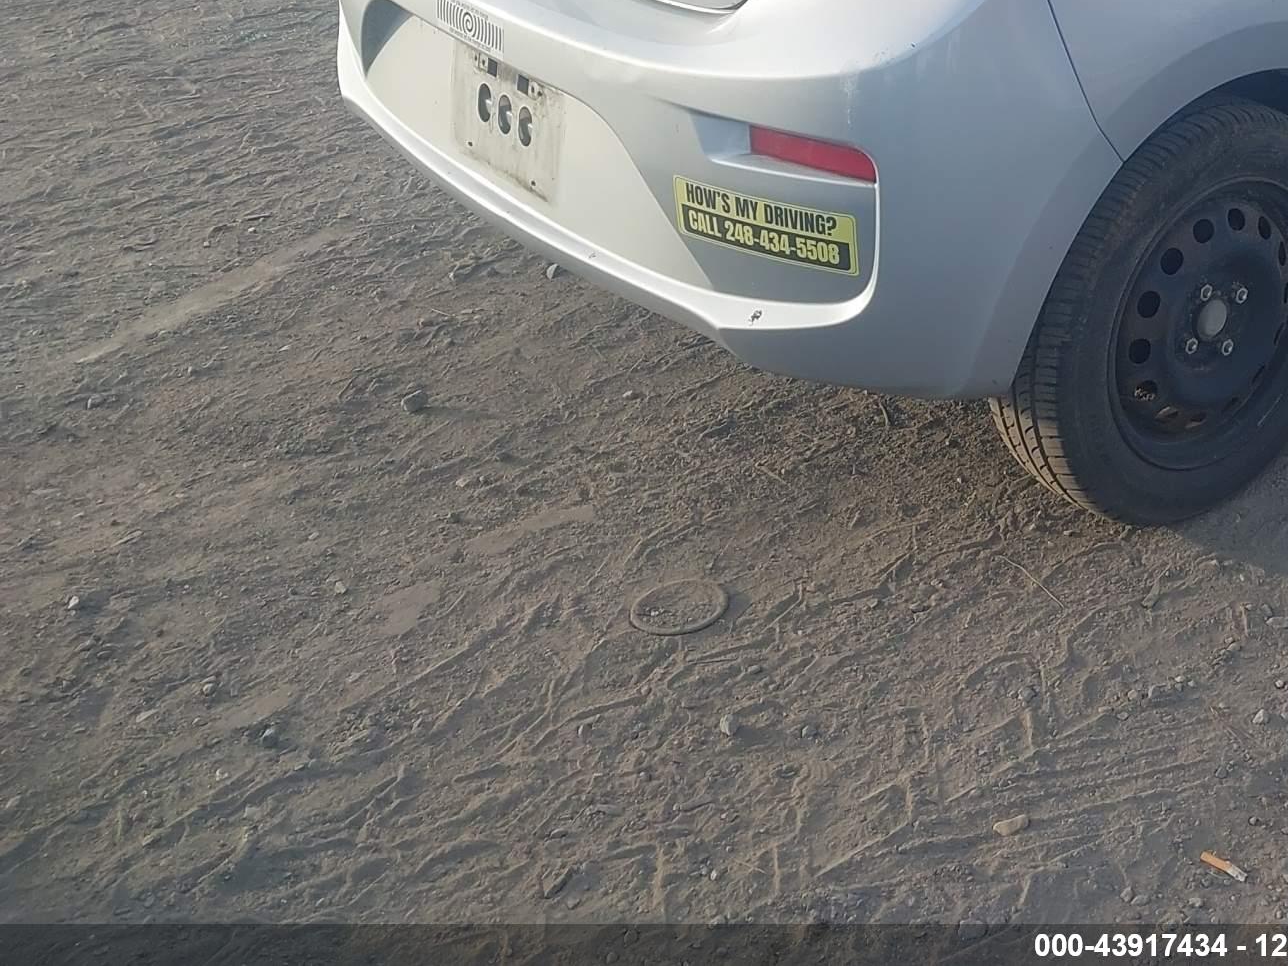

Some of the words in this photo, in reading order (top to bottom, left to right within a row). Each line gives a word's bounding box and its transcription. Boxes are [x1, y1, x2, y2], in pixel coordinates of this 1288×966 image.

[685, 182, 731, 214] HOW'S
[735, 196, 760, 222] MY
[763, 203, 838, 237] DRIVING?
[688, 209, 723, 238] CALL
